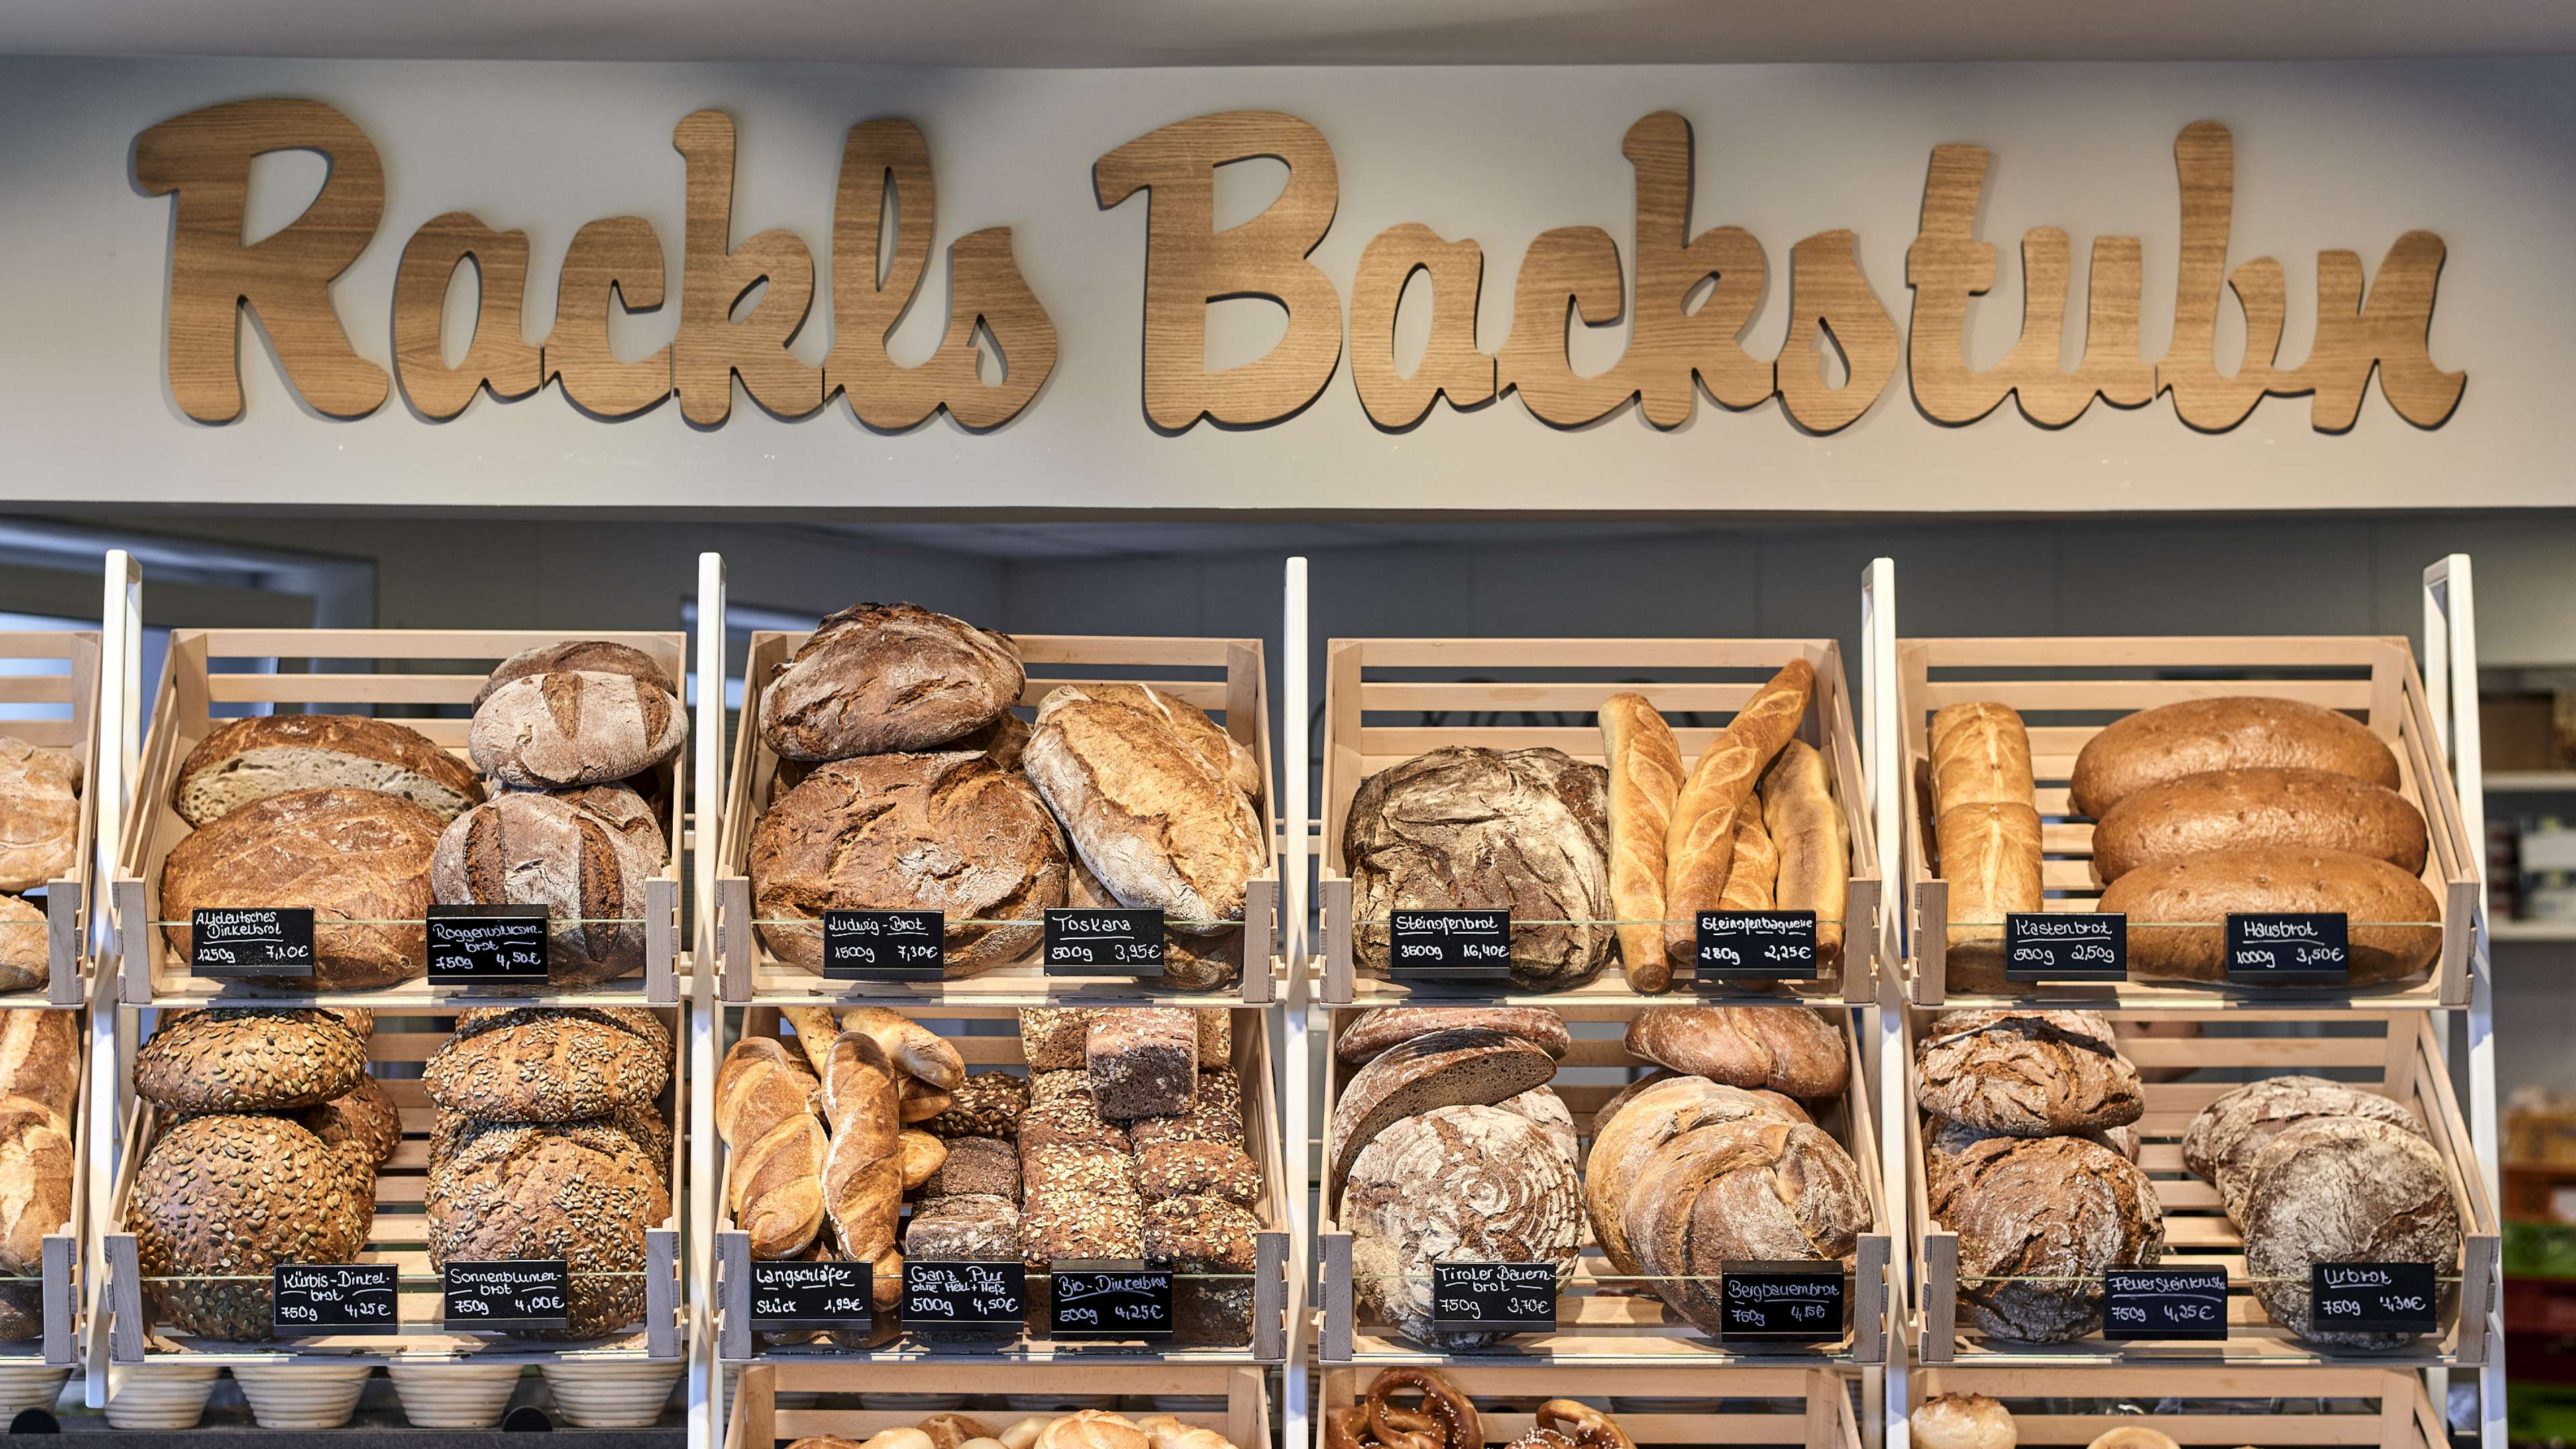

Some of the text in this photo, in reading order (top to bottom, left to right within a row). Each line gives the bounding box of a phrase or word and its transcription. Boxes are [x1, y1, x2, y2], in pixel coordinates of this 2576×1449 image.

[131, 96, 2467, 433] Rackls Backstubn
[207, 922, 283, 938] Dinkelbrot
[1052, 915, 1132, 933] Toskana
[1396, 916, 1499, 936] Steinofenbrot
[1702, 917, 1813, 936] Steinofenbaguette
[2016, 919, 2113, 936] Kastenbrot
[2244, 921, 2318, 938] Hausbrot
[465, 941, 499, 953] brot
[835, 946, 938, 963] 1500g 7,30€
[1052, 945, 1162, 963] 500g 3,95€
[1401, 945, 1509, 961] 3500g 16,40€
[1701, 945, 1812, 965] 280g 2,25€
[198, 949, 235, 963] 1250g
[435, 952, 541, 970] 750g 4,50€
[2014, 949, 2055, 966] 500g
[2237, 948, 2345, 969] 1000g 3,50€
[451, 1269, 563, 1285] Sonnenblumen-
[756, 1265, 852, 1288] Langschläfer
[911, 1267, 1004, 1284] Ganz Pur
[1436, 1268, 1494, 1281] Tiroler
[2324, 1269, 2393, 1285] Urbrot
[480, 1284, 513, 1296] brot
[912, 1283, 938, 1294] ohne
[945, 1283, 971, 1293] Mehl
[981, 1282, 1006, 1296] Hefe
[1473, 1280, 1510, 1293] brot
[1729, 1281, 1840, 1302] Bergbauernbrot
[311, 1289, 344, 1302] brot
[281, 1302, 391, 1322] 750g 4,25€
[455, 1297, 565, 1316] 750g 4,00€
[757, 1298, 863, 1314] Stück 1,99€
[910, 1298, 1019, 1316] 500g 4,50€
[1439, 1297, 1551, 1320] 750g 3,70€
[2111, 1305, 2215, 1324] 750g 4,25€
[2322, 1295, 2426, 1317] 750g 4,30€
[1060, 1305, 1165, 1325] 500g 4,25€
[1731, 1309, 1766, 1326] 750g
